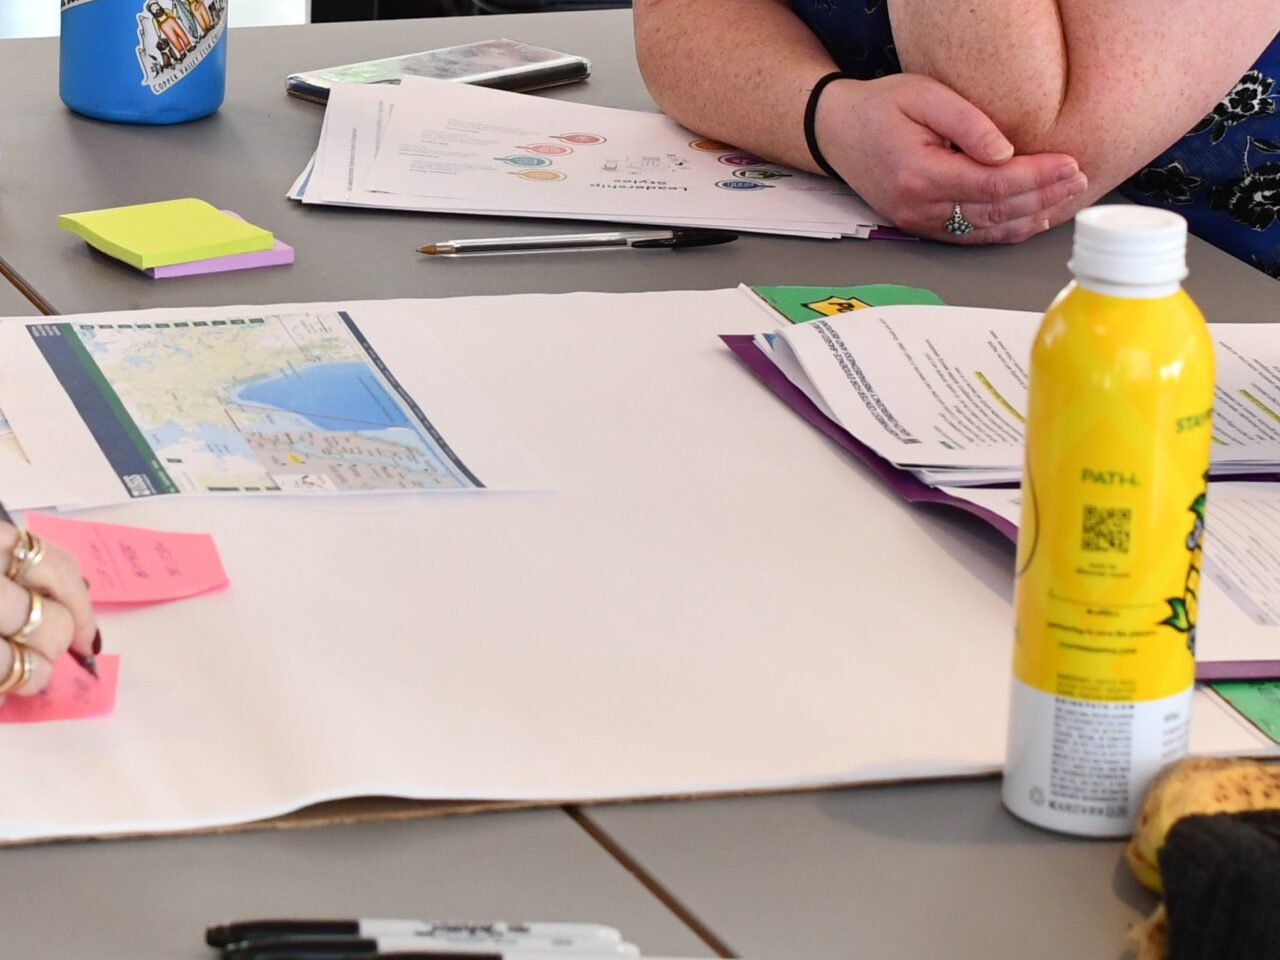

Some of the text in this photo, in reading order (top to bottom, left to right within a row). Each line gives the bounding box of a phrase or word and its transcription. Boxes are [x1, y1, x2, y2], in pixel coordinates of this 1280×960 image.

[151, 73, 179, 94] COPPER
[179, 56, 200, 75] VALLEY
[589, 182, 688, 192] Leadership
[613, 178, 667, 186] Styles
